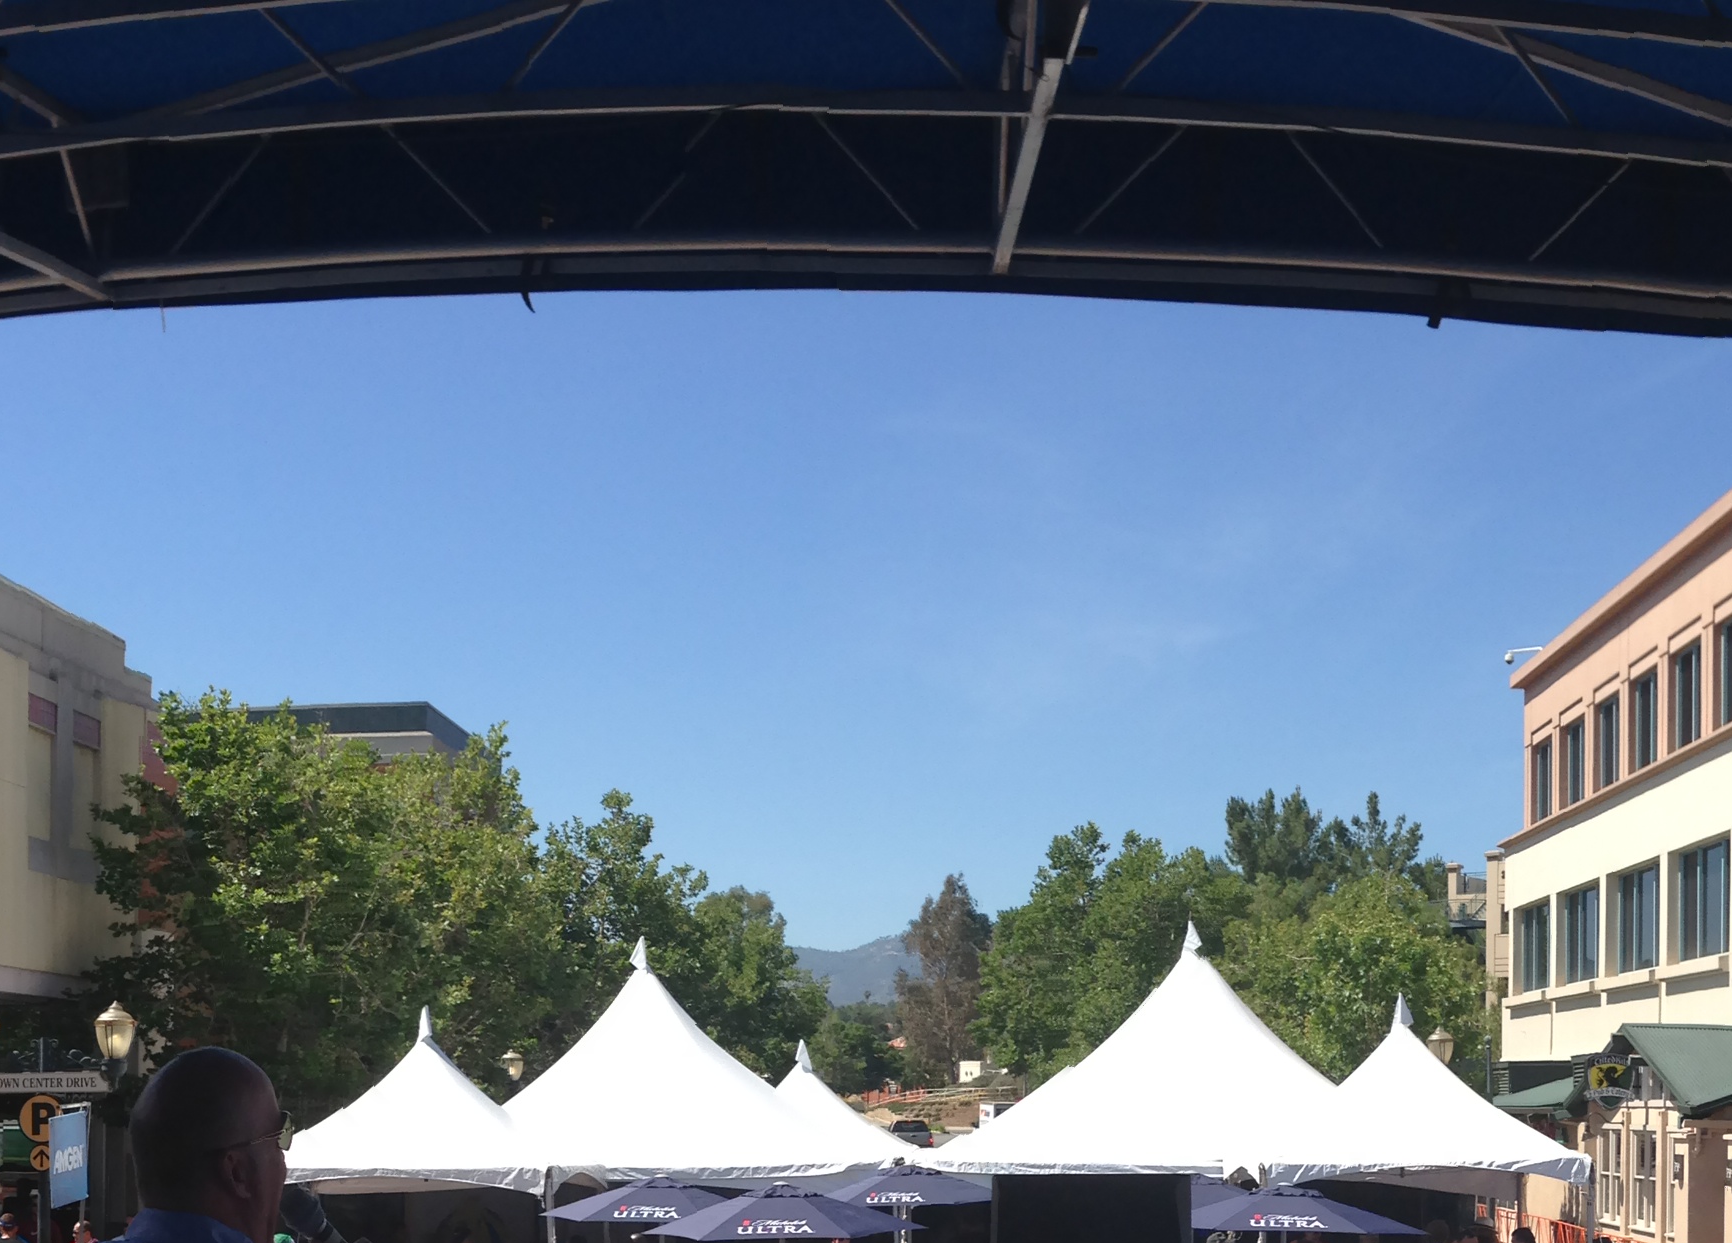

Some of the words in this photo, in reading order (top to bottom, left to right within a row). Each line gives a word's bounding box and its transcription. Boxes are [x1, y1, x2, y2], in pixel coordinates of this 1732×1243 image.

[22, 1077, 63, 1089] CENTER
[66, 1077, 96, 1088] DRIVE
[32, 1103, 55, 1135] P
[54, 1144, 83, 1175] AMGEN
[866, 1196, 924, 1204] ULTRA
[613, 1211, 680, 1219] ULTRA
[1250, 1219, 1327, 1228] ULTRA
[737, 1225, 814, 1235] ULTRA
